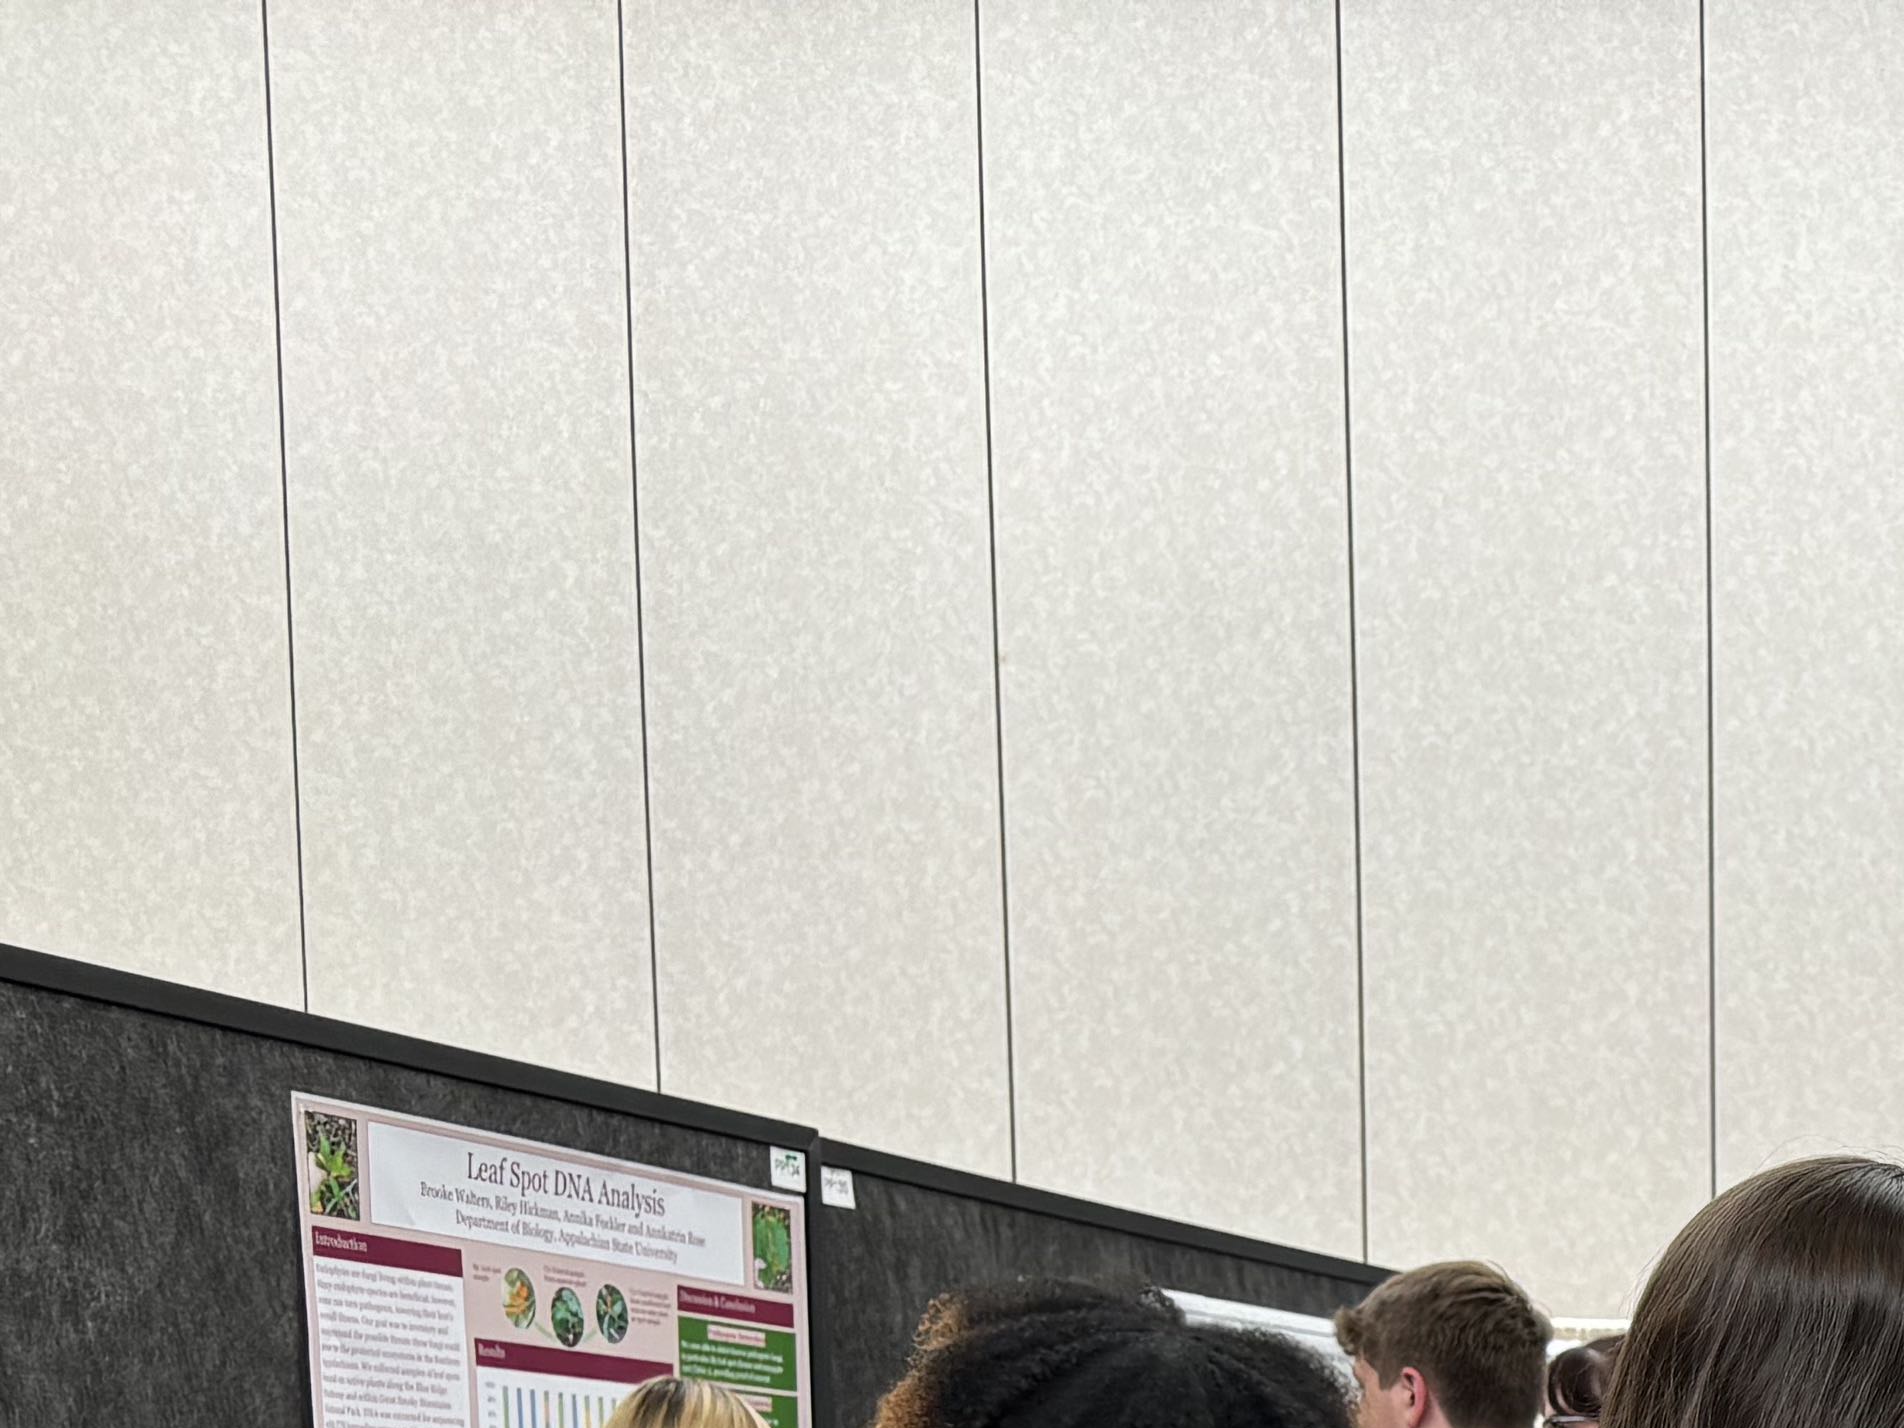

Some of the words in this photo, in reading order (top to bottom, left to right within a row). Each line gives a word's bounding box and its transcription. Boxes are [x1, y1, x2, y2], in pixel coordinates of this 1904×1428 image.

[420, 1181, 453, 1200] Brooke
[495, 1195, 517, 1215] Riley
[628, 1221, 644, 1235] and
[467, 1152, 507, 1184] Leaf
[509, 1162, 548, 1196] Spot
[554, 1170, 593, 1201] DNA
[597, 1181, 665, 1217] Analysis
[455, 1209, 508, 1231] Department
[511, 1219, 520, 1233] of
[522, 1221, 556, 1242] Biology,
[560, 1229, 609, 1249] Appalachian
[611, 1238, 632, 1253] State
[635, 1242, 677, 1263] University
